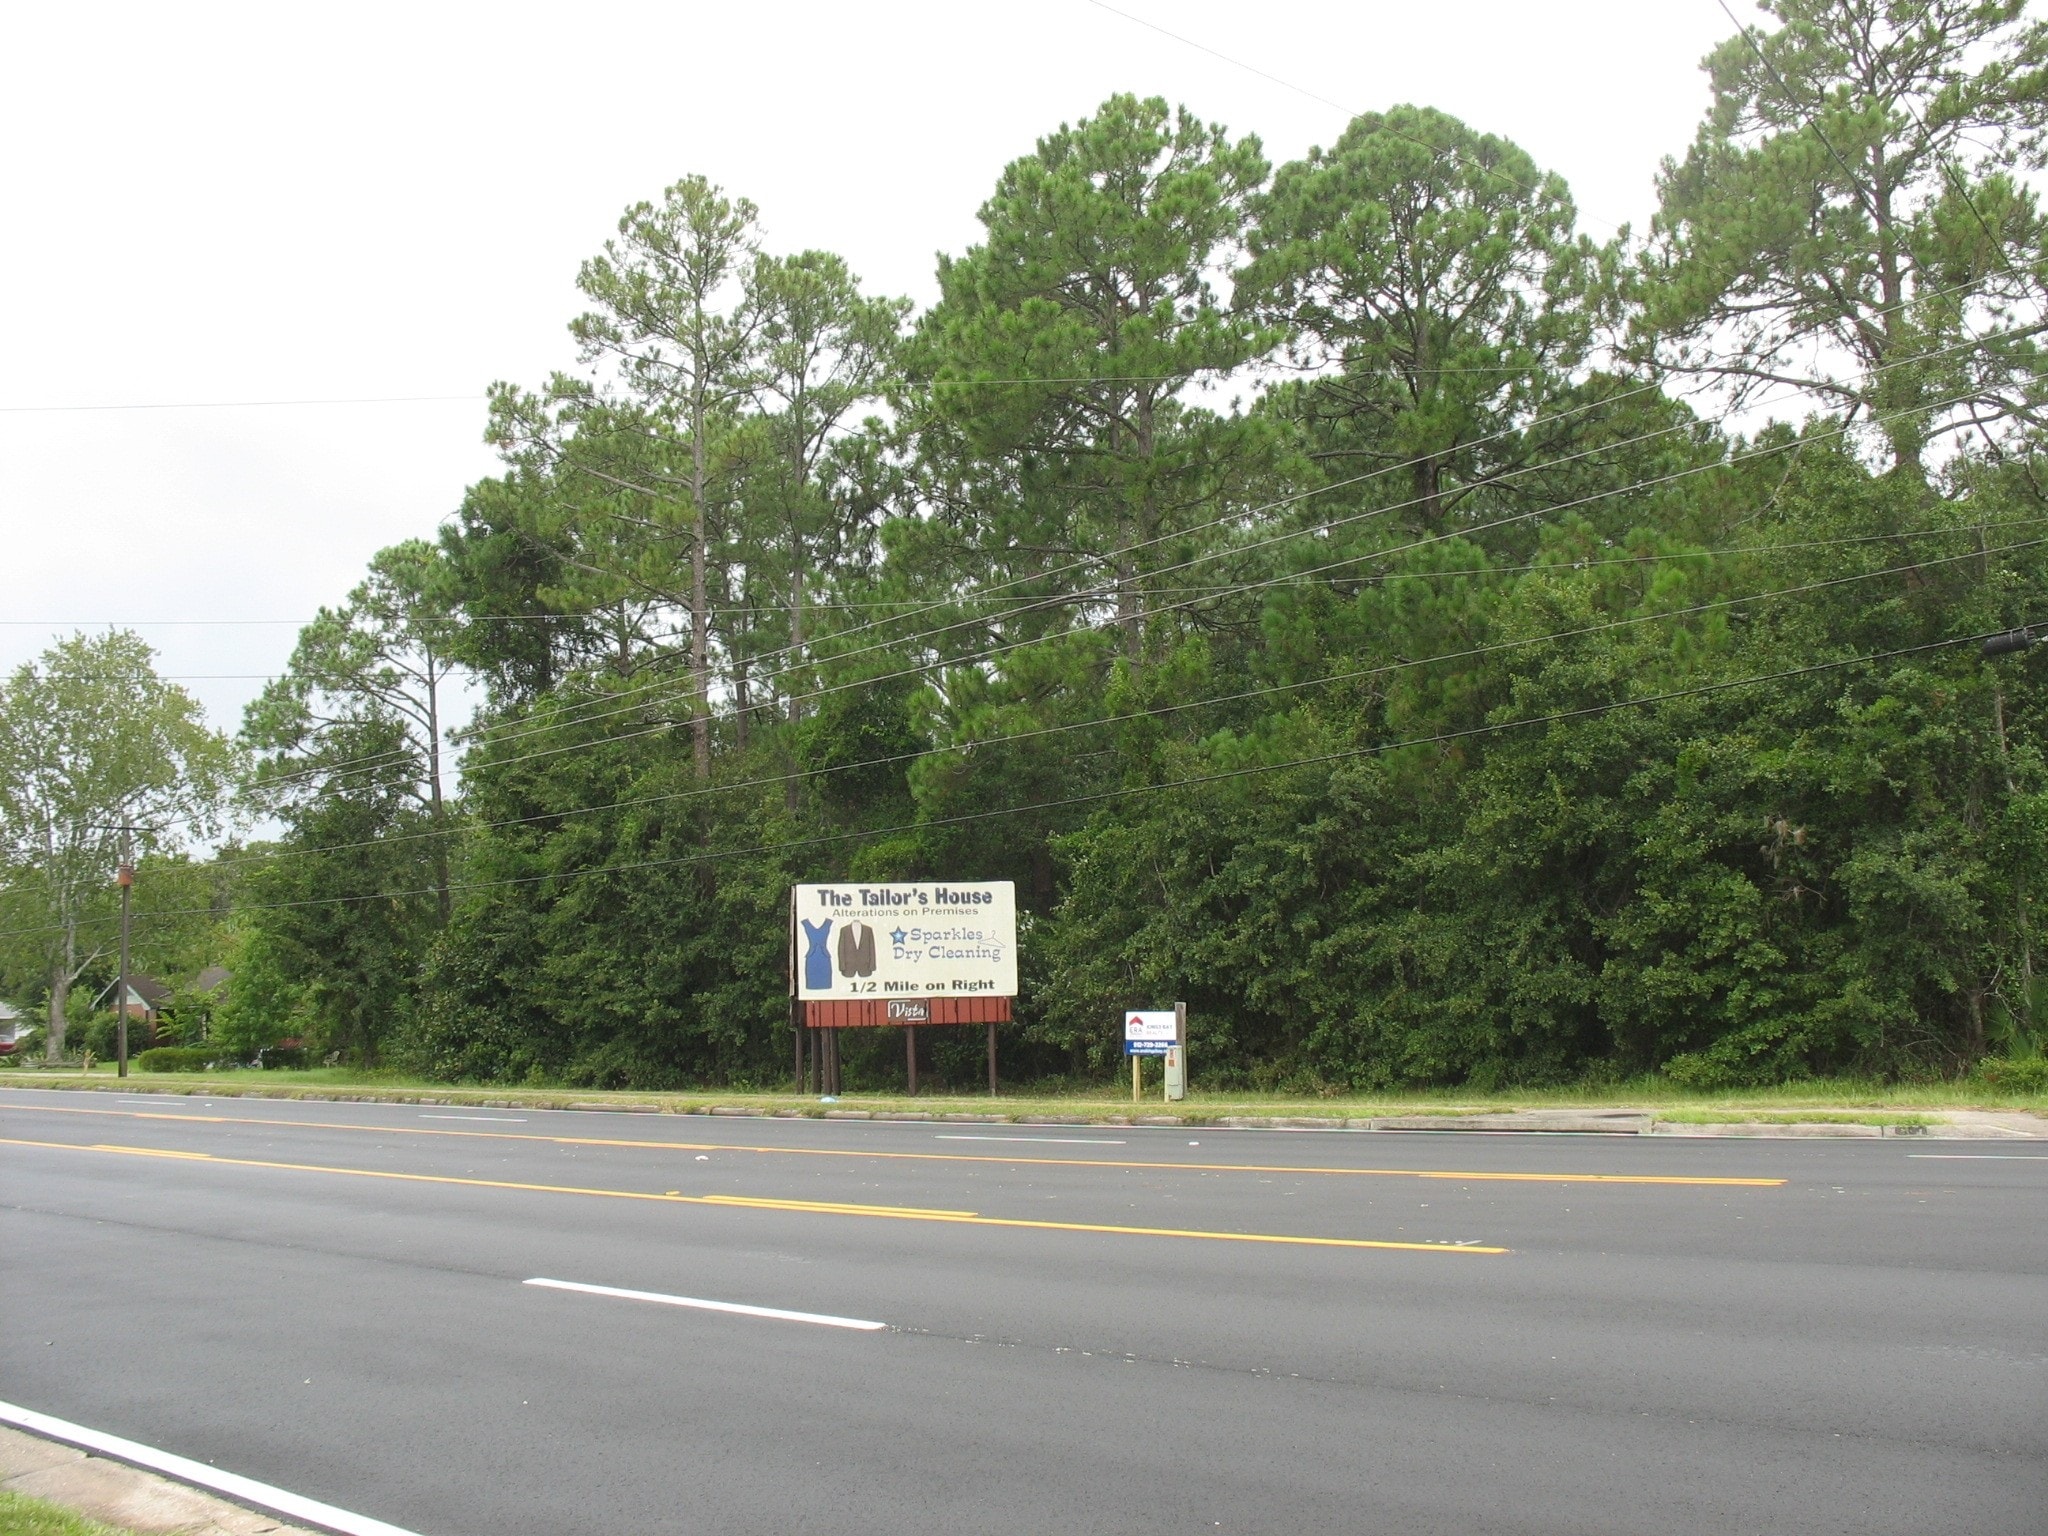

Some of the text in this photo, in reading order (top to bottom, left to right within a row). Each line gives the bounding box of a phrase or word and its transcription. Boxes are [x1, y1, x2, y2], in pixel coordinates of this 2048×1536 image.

[817, 888, 992, 906] The Tailor's House
[832, 908, 899, 917] Alterations
[923, 907, 979, 915] Premises
[910, 927, 983, 943] Sparkles
[893, 945, 1001, 963] Dry Cleaning
[850, 979, 995, 993] 1/2 Mile on Right
[890, 1003, 925, 1018] Vista
